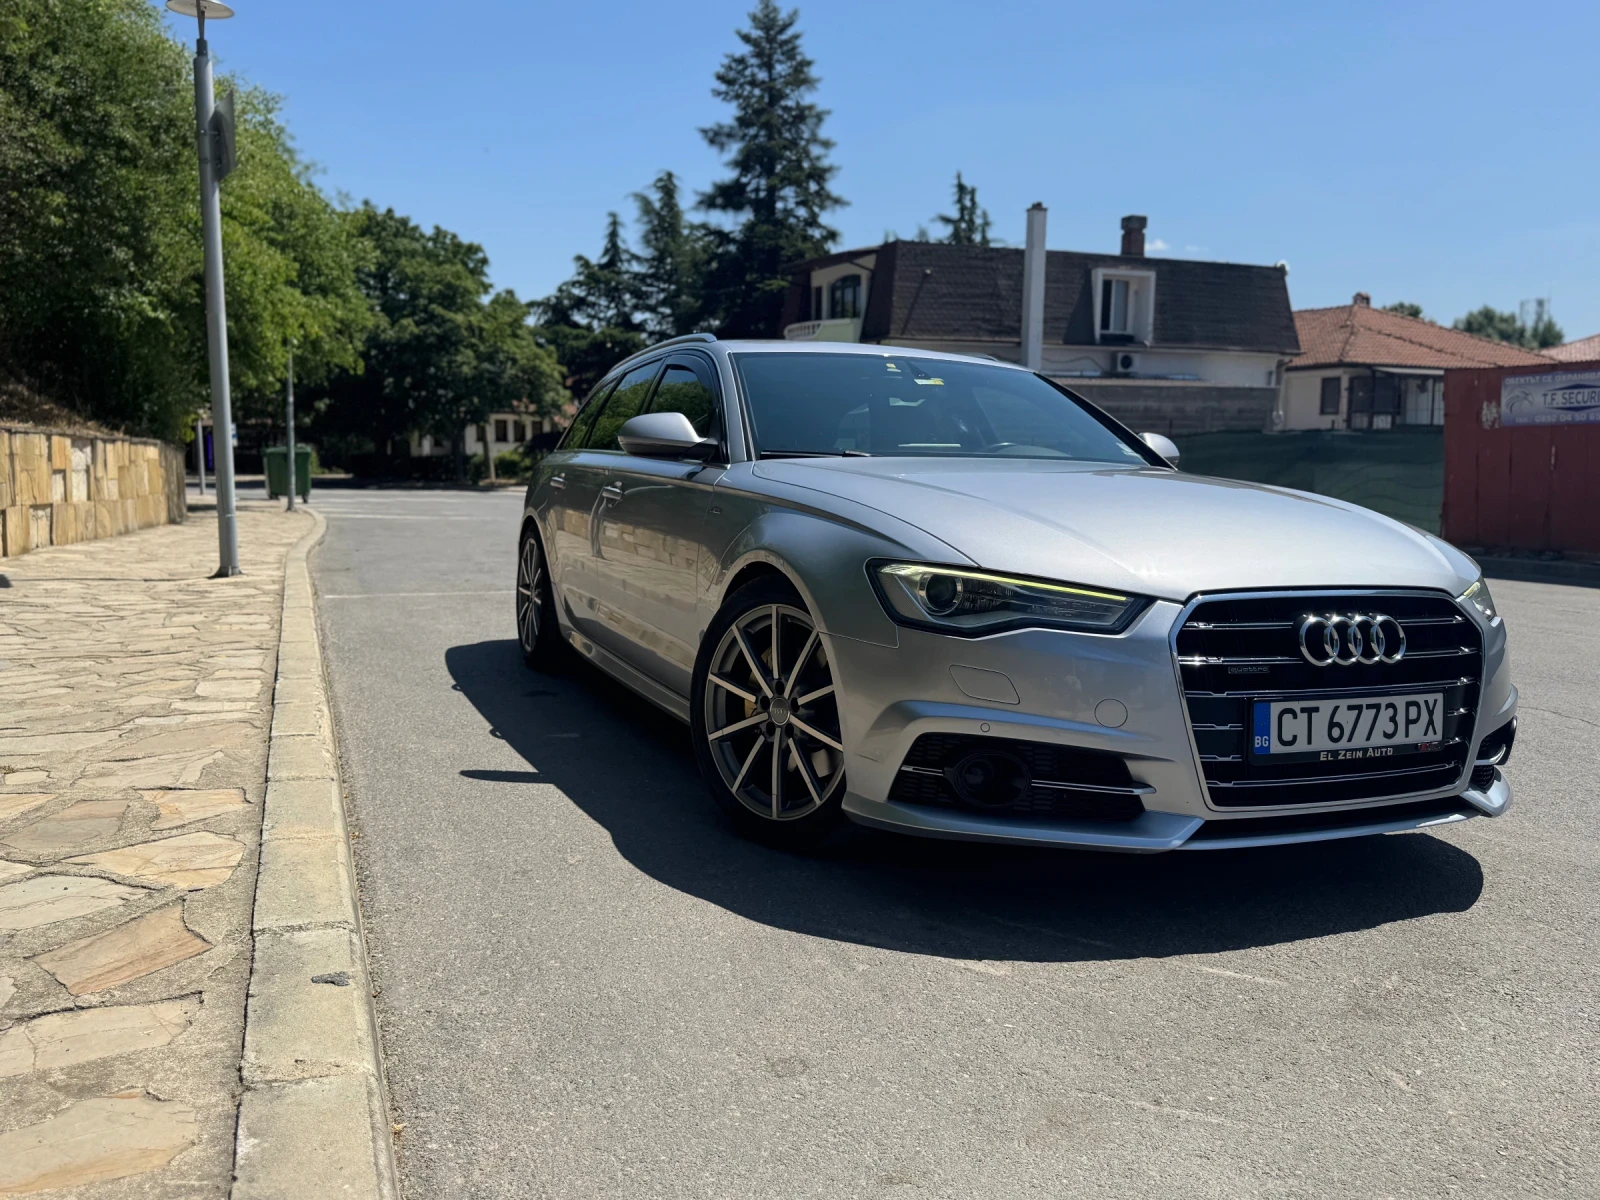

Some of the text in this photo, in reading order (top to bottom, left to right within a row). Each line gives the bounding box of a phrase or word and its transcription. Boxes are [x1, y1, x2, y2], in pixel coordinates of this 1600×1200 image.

[1277, 698, 1438, 747] CT 6773 PX
[1254, 735, 1269, 748] BG
